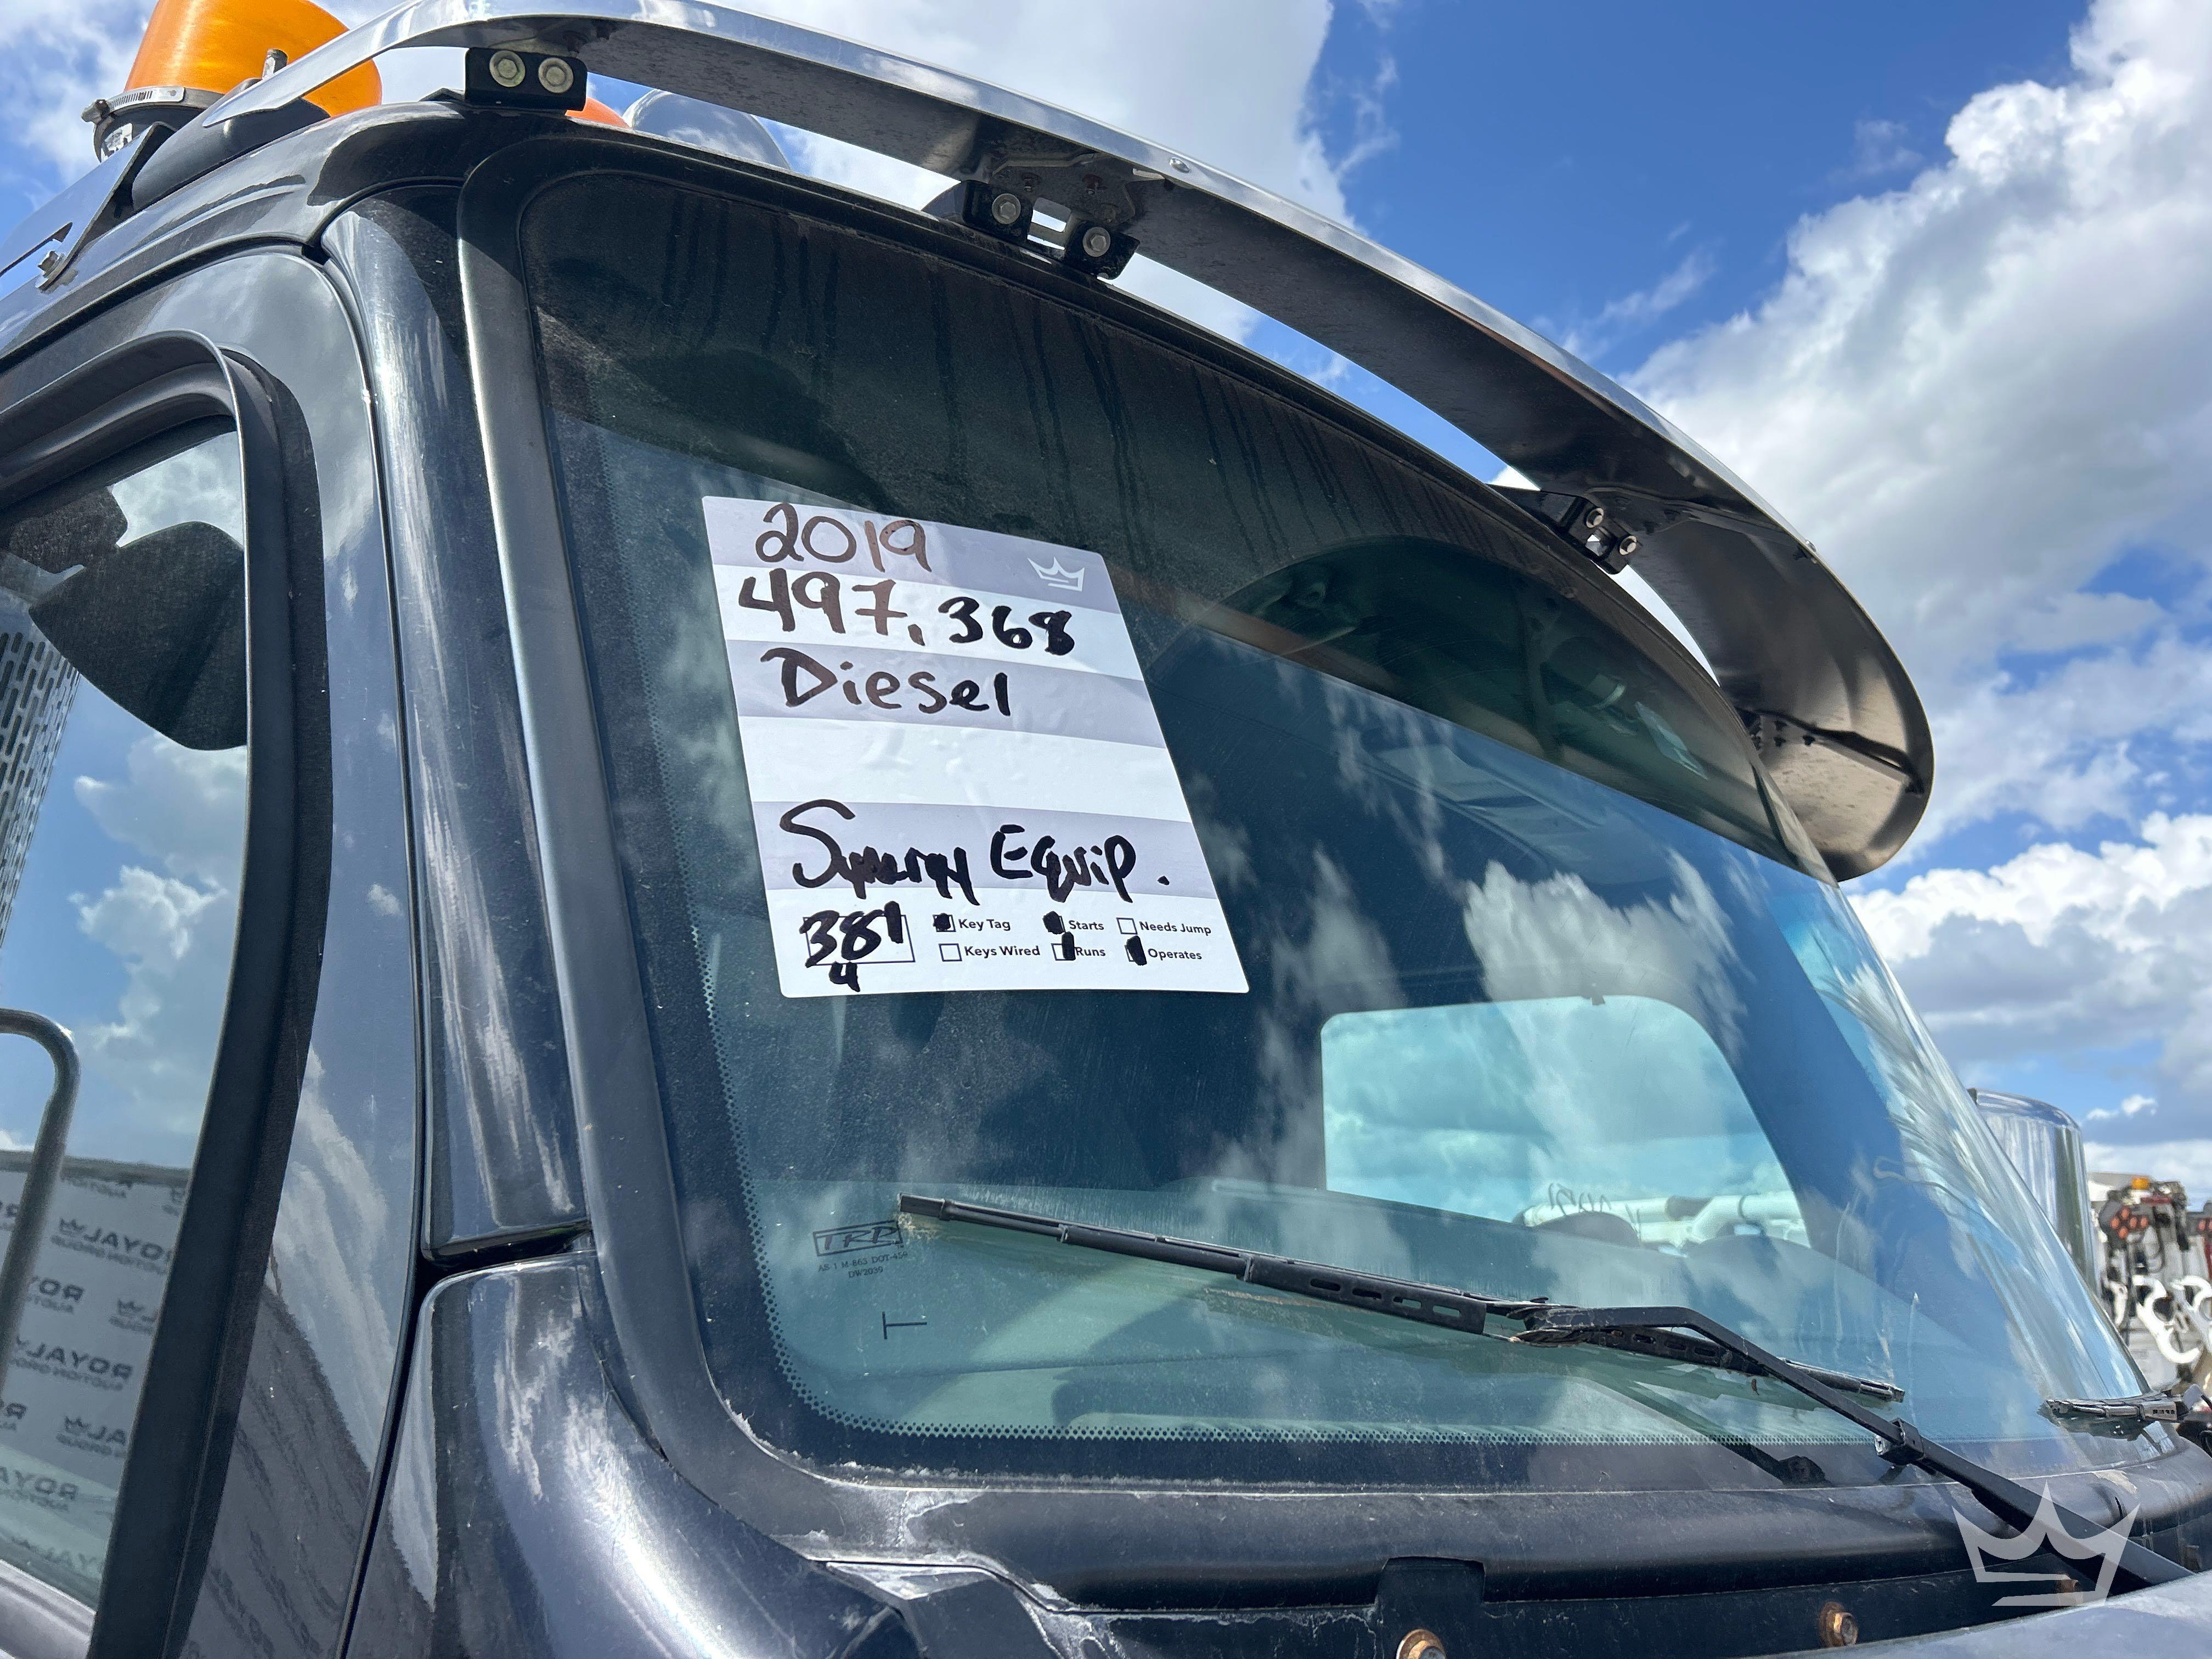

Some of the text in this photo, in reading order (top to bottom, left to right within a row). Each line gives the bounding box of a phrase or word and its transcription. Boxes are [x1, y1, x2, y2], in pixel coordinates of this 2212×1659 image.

[755, 502, 932, 572] 2019
[760, 647, 1011, 716] Diesel
[958, 918, 1011, 932] Key Tag
[1069, 919, 1105, 930] Starts
[1139, 921, 1211, 936] Needs Jump
[964, 945, 1041, 959] Keys Wired
[1075, 946, 1106, 956] Runs
[1148, 948, 1203, 961] Operates
